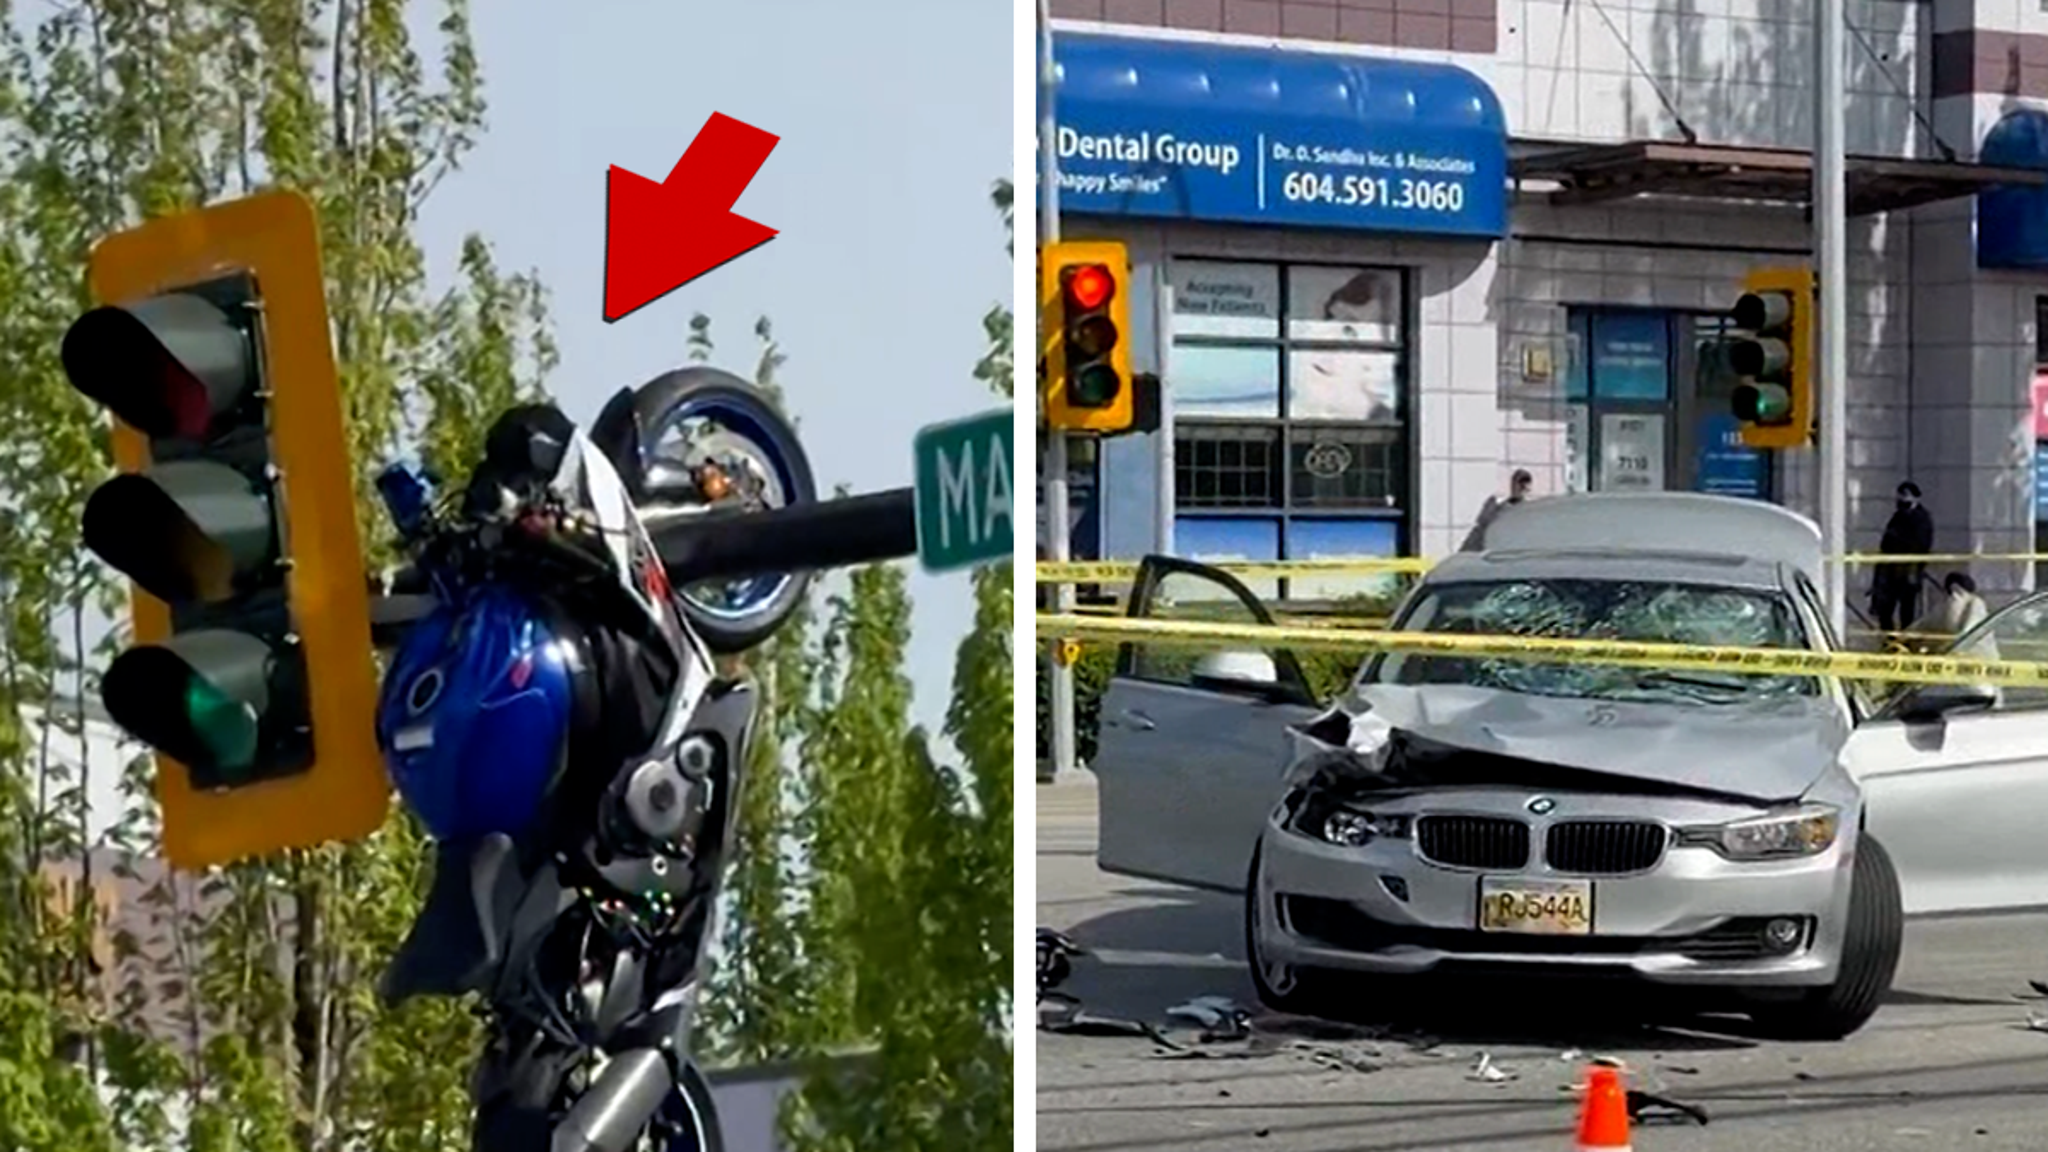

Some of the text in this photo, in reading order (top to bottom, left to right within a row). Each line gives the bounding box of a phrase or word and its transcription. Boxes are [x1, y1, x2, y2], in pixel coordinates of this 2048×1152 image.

[1058, 126, 1240, 175] Dental Group
[1283, 171, 1463, 212] 604.591.3060
[936, 432, 1014, 550] MA
